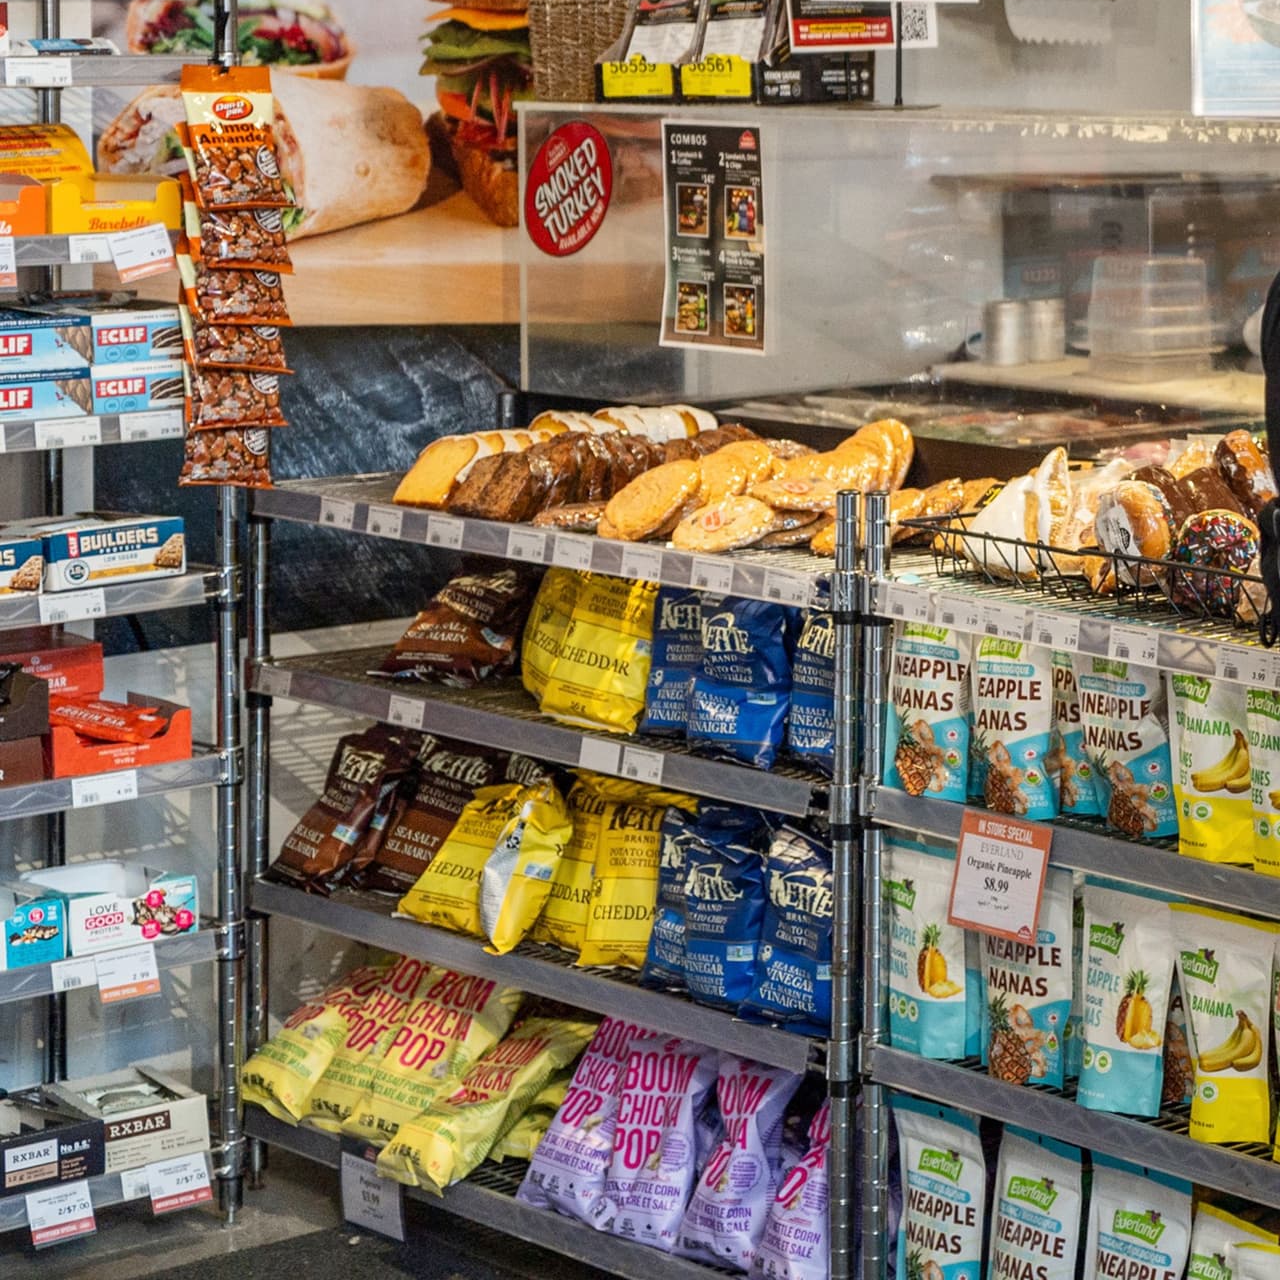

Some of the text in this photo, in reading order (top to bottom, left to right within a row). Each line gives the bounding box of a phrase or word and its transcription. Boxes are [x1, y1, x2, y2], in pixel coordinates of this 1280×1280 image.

[534, 137, 597, 218] SMOKED
[544, 167, 605, 243] TURKEY
[107, 327, 147, 343] CLIF
[80, 526, 159, 553] BUILDERS
[560, 649, 630, 678] CHEDDAR
[86, 911, 125, 930] GOOD
[89, 902, 120, 918] LOVE
[625, 1047, 699, 1094] BOOM
[620, 1093, 681, 1127] CHICKA
[110, 1114, 165, 1139] RXBAR
[612, 1129, 665, 1171] POP
